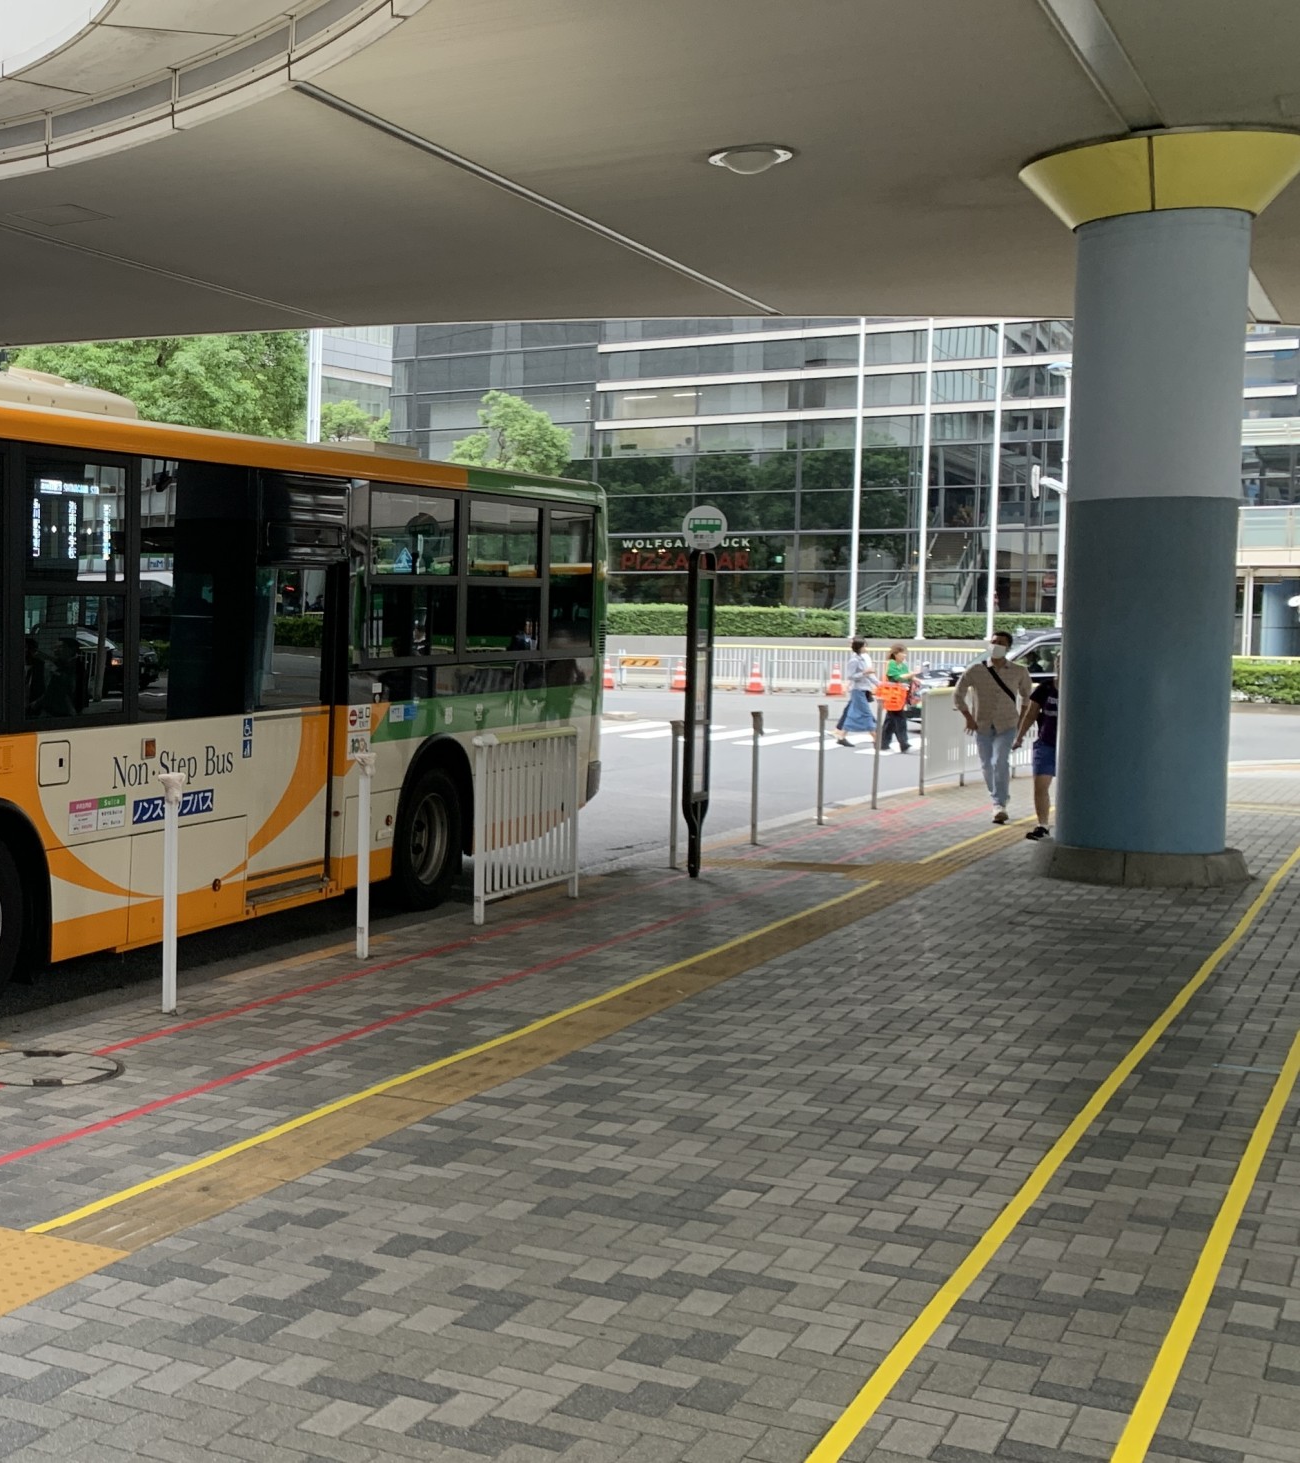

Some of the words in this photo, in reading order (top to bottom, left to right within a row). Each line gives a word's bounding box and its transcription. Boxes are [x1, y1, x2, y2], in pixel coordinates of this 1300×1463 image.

[721, 538, 750, 547] UCK
[621, 552, 689, 570] PIZZA
[204, 745, 234, 777] Bus
